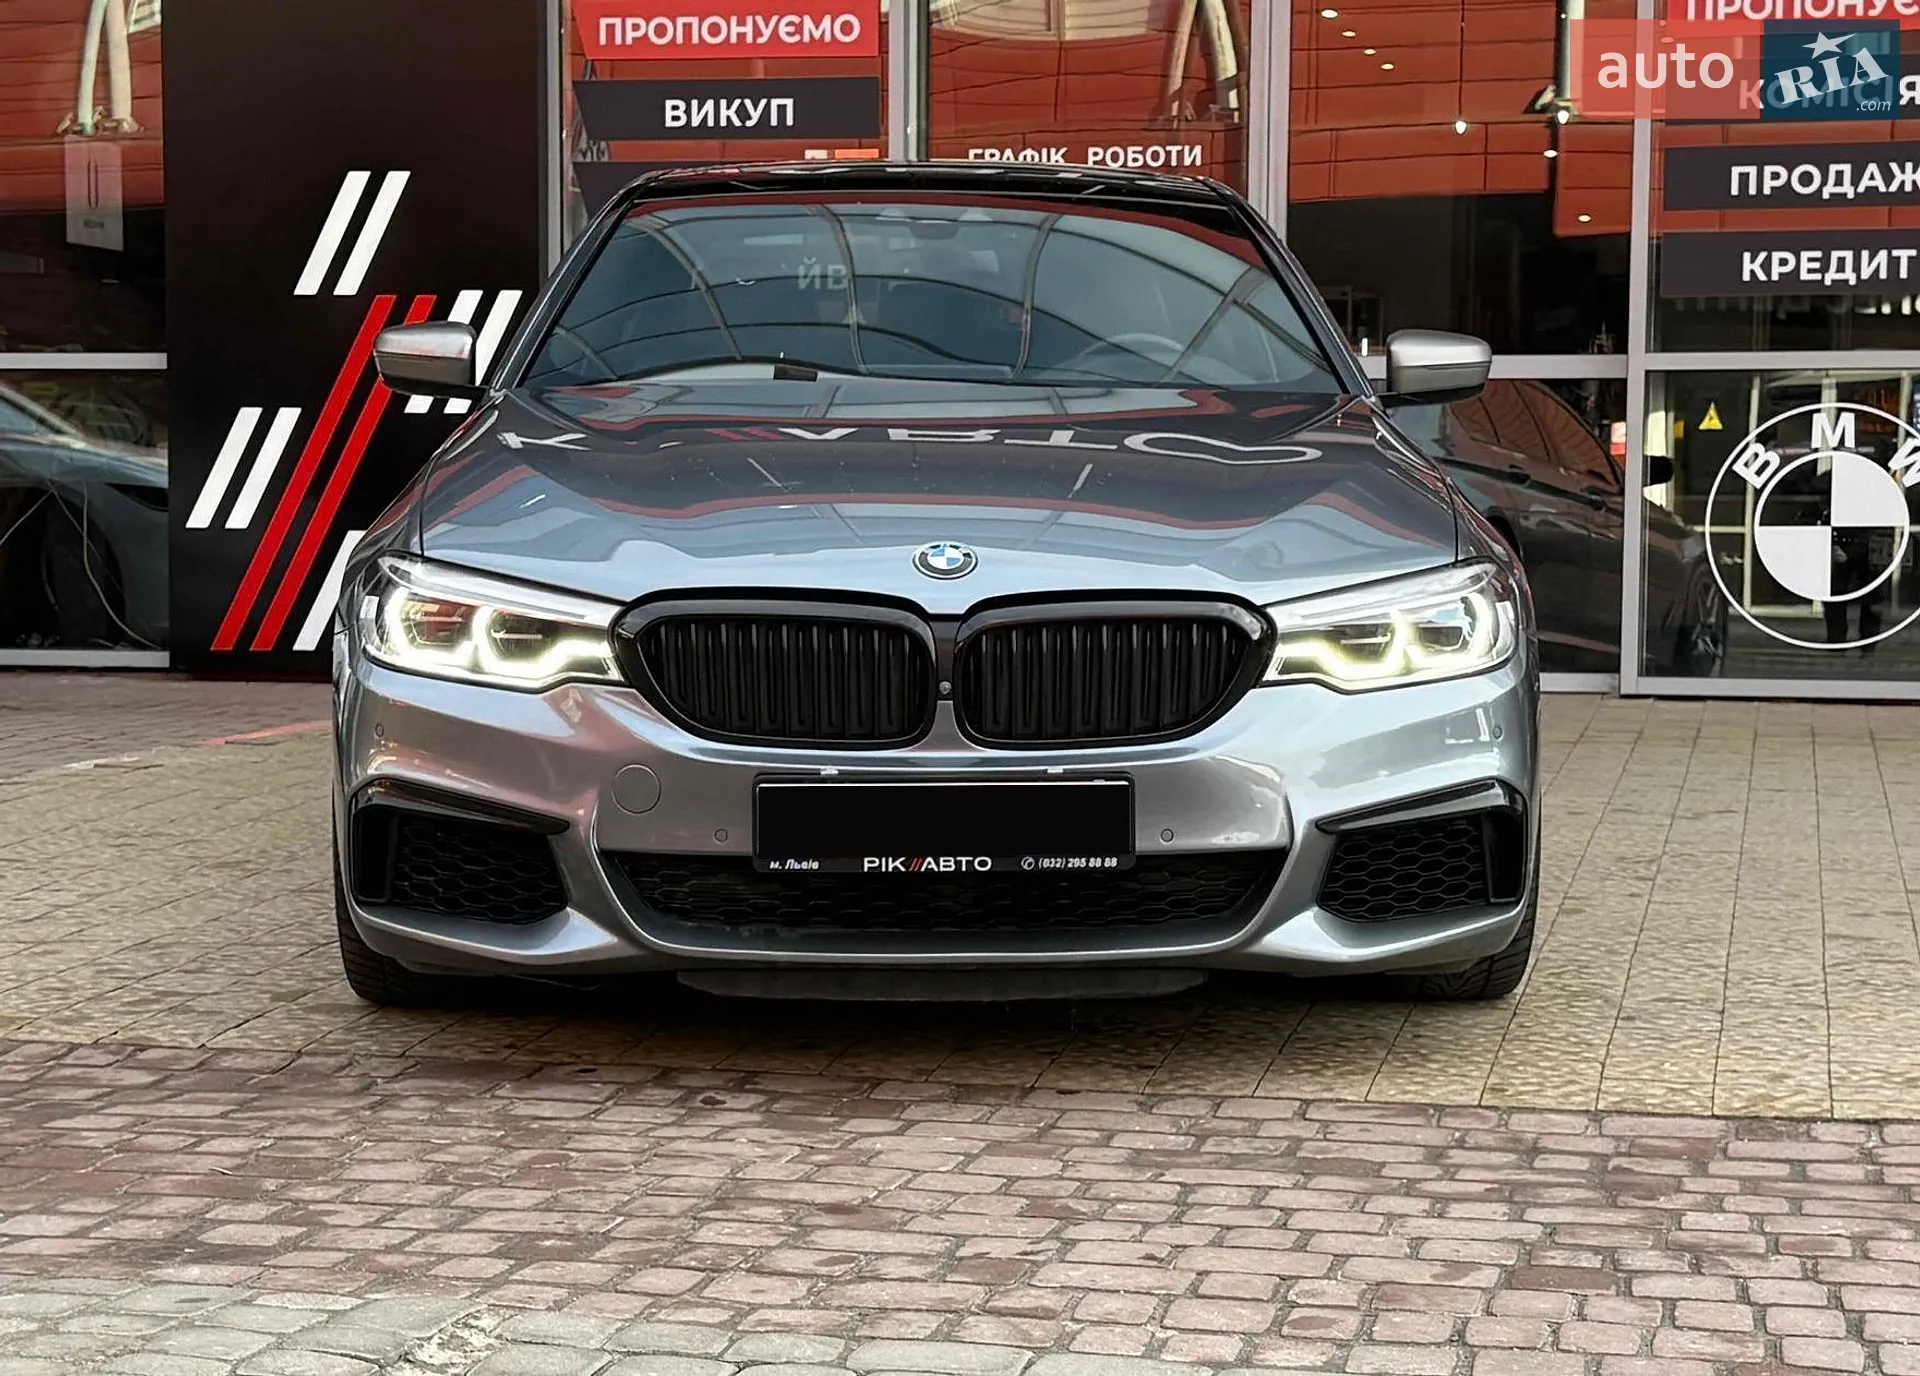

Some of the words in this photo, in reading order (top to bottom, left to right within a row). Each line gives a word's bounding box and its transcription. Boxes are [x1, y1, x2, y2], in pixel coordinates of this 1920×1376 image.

[598, 13, 862, 46] ПРОПОНУЄМО
[663, 98, 796, 129] ВИКУП
[1087, 145, 1203, 168] РОБОТИ
[1730, 162, 1920, 200] ПРОДАЖ
[1741, 248, 1918, 286] КРЕДИТ
